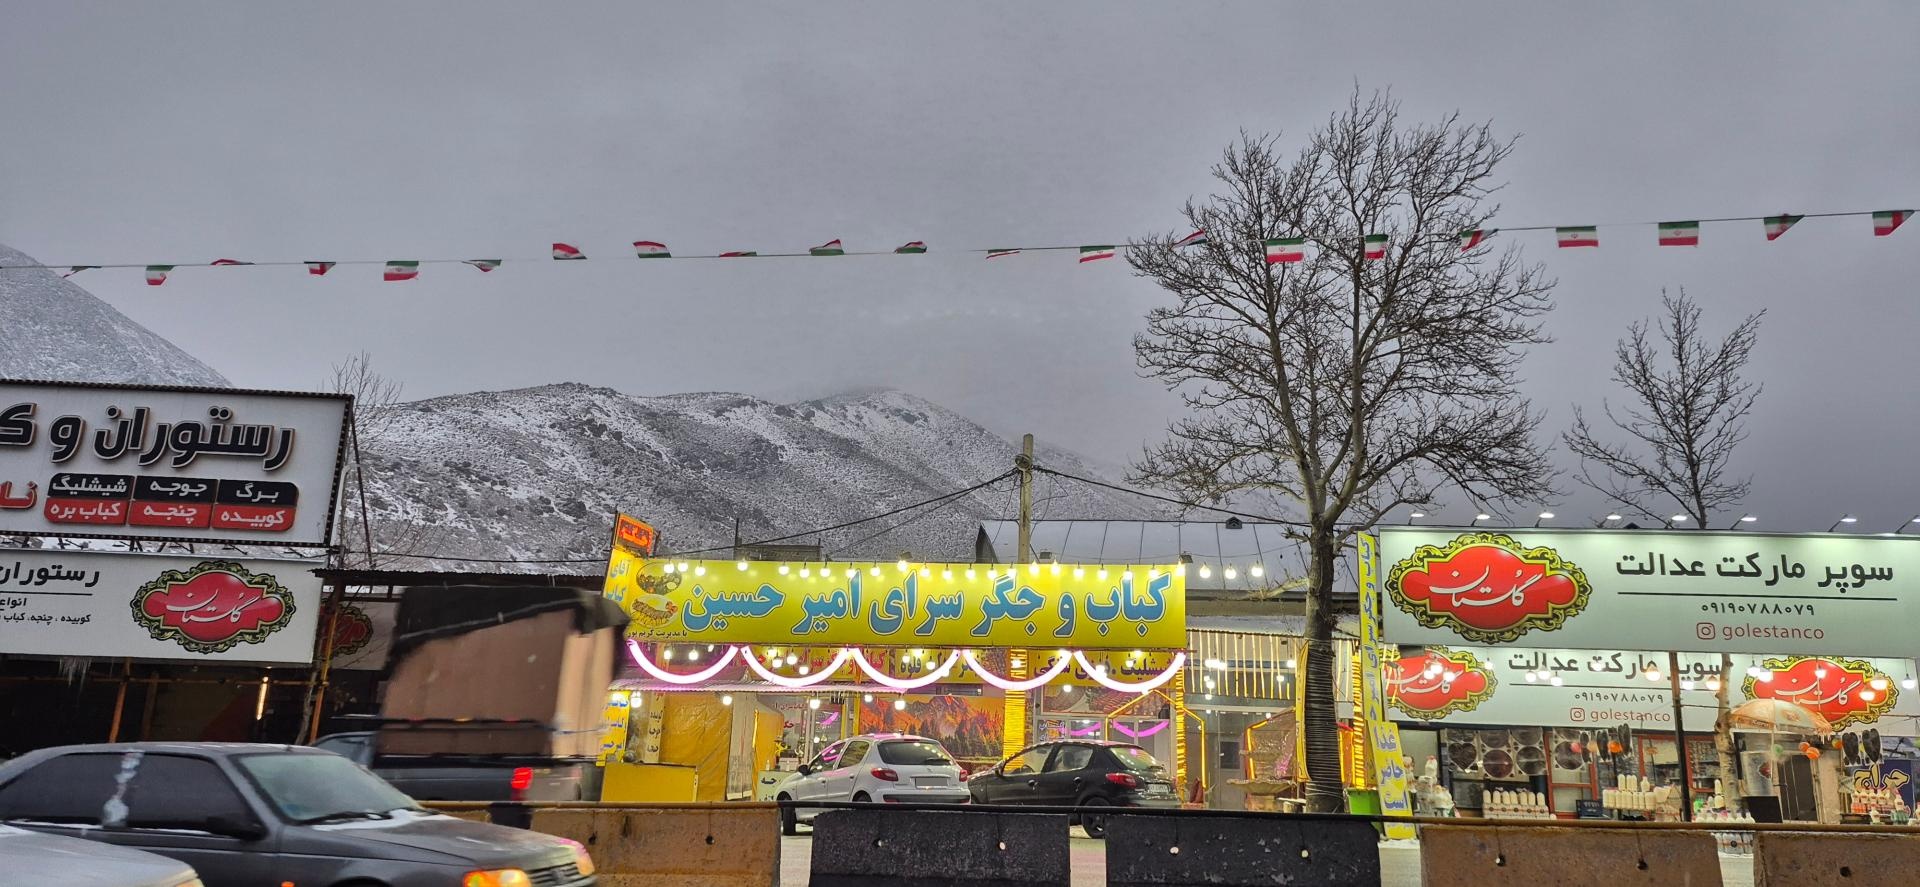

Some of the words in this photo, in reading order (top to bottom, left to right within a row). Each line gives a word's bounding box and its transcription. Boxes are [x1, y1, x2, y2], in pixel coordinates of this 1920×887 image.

[49, 415, 86, 463] و
[94, 405, 295, 471] رستوران
[150, 479, 208, 497] جوجه
[235, 484, 279, 503] برگ
[50, 503, 77, 520] بره
[80, 502, 121, 520] کباب
[143, 506, 198, 525] چنجه
[221, 510, 285, 528] کوبیده
[1615, 551, 1707, 578] عدالت
[1715, 551, 1806, 586] مارکت
[1817, 563, 1894, 594] سوپر
[680, 582, 784, 633] حسین
[791, 569, 863, 637] امیر
[868, 569, 966, 638] سرای
[969, 572, 1047, 638] جگر
[1054, 591, 1077, 639] و
[1084, 572, 1171, 638] کباب
[1701, 602, 1815, 616] ۰۹۱۹۰۷۸۸۰۷۹
[1722, 622, 1825, 641] golestanco
[1508, 651, 1579, 672] عدالت
[1574, 691, 1664, 704] ۰۹۱۹۰۷۸۸۰۷۹
[1590, 707, 1671, 723] golestanco
[1374, 727, 1397, 750] غذا
[1380, 758, 1404, 786] حاضر
[1854, 762, 1911, 792] حراج
